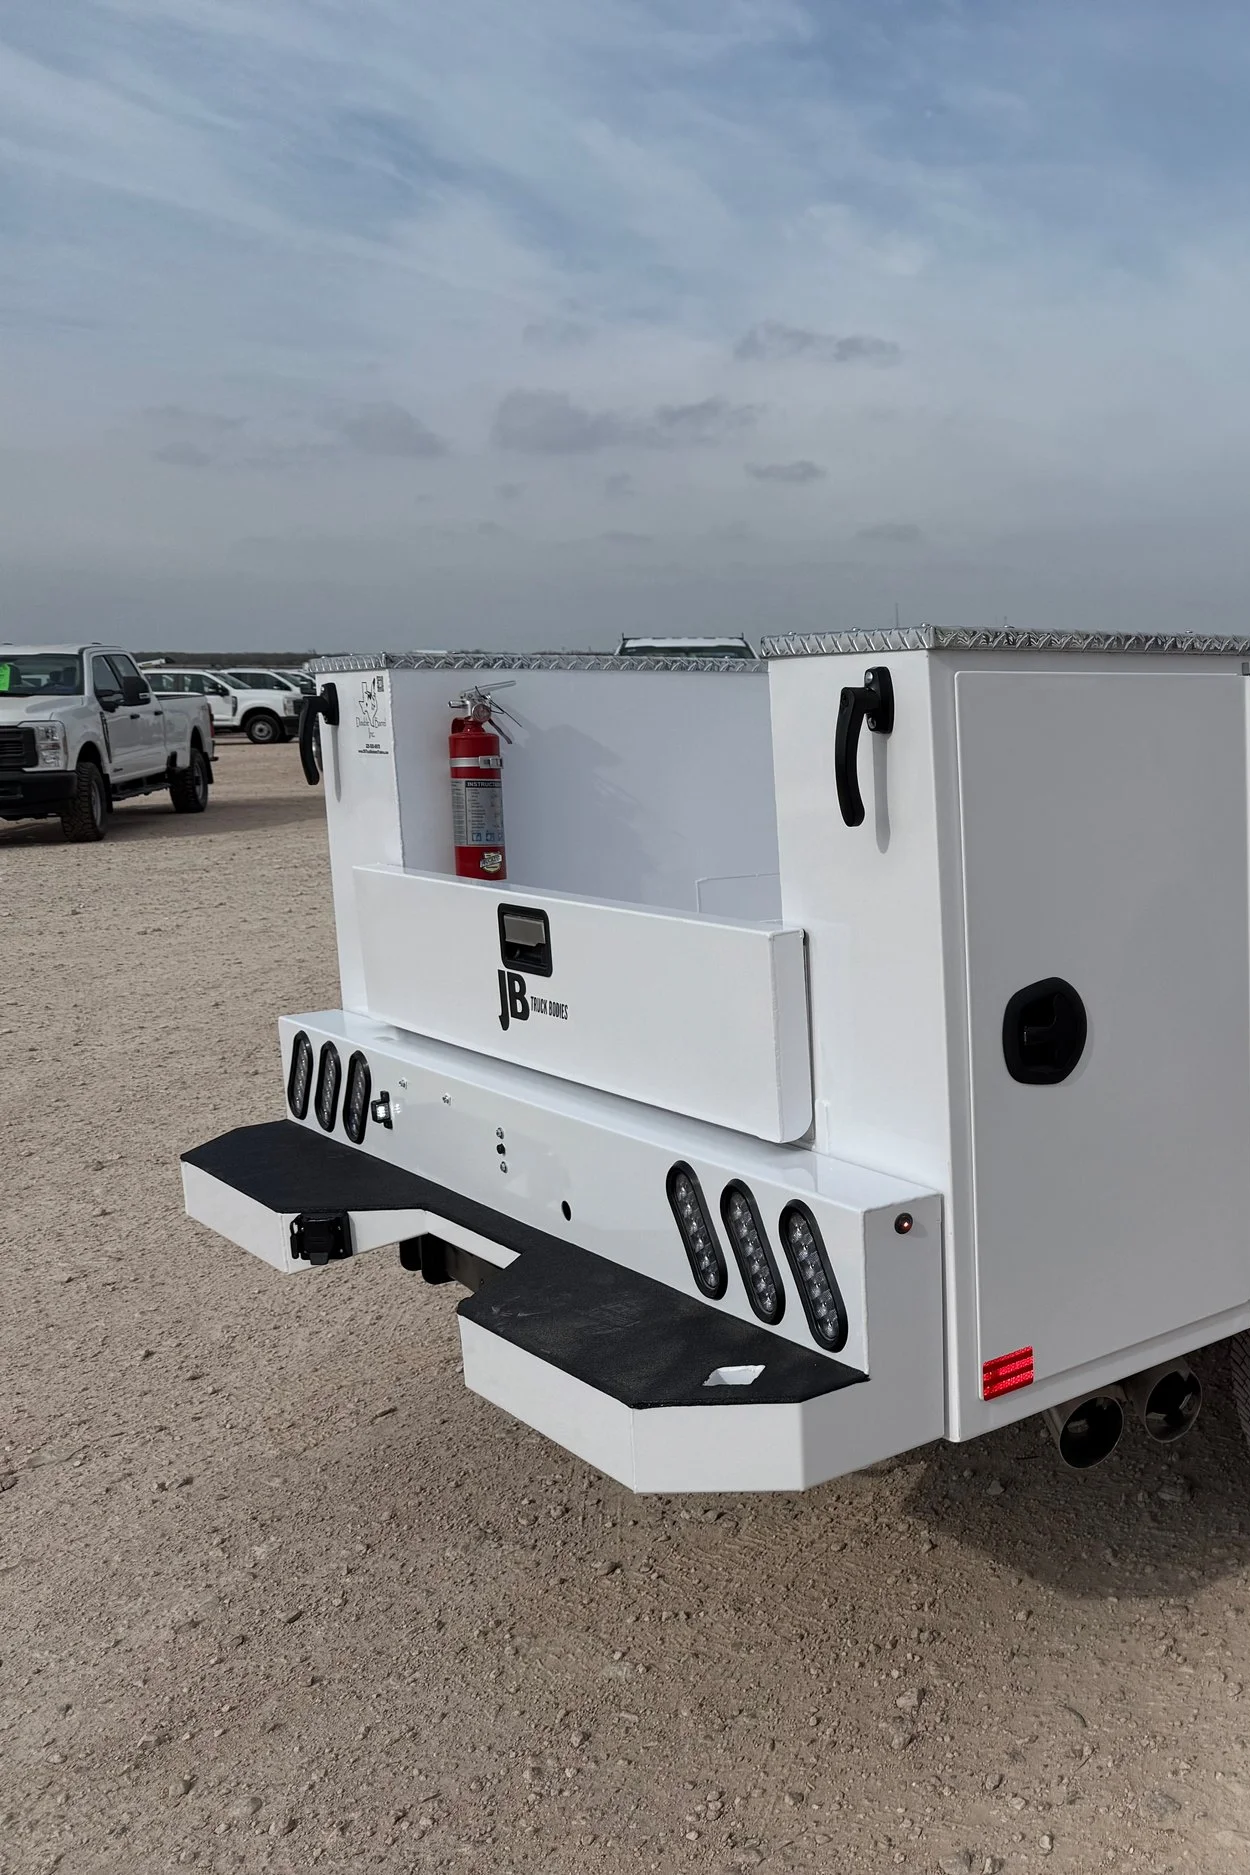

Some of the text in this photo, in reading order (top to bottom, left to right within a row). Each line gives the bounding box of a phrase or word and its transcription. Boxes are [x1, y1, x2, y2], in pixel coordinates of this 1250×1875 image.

[498, 969, 569, 1031] JB TRUCK BODIES
